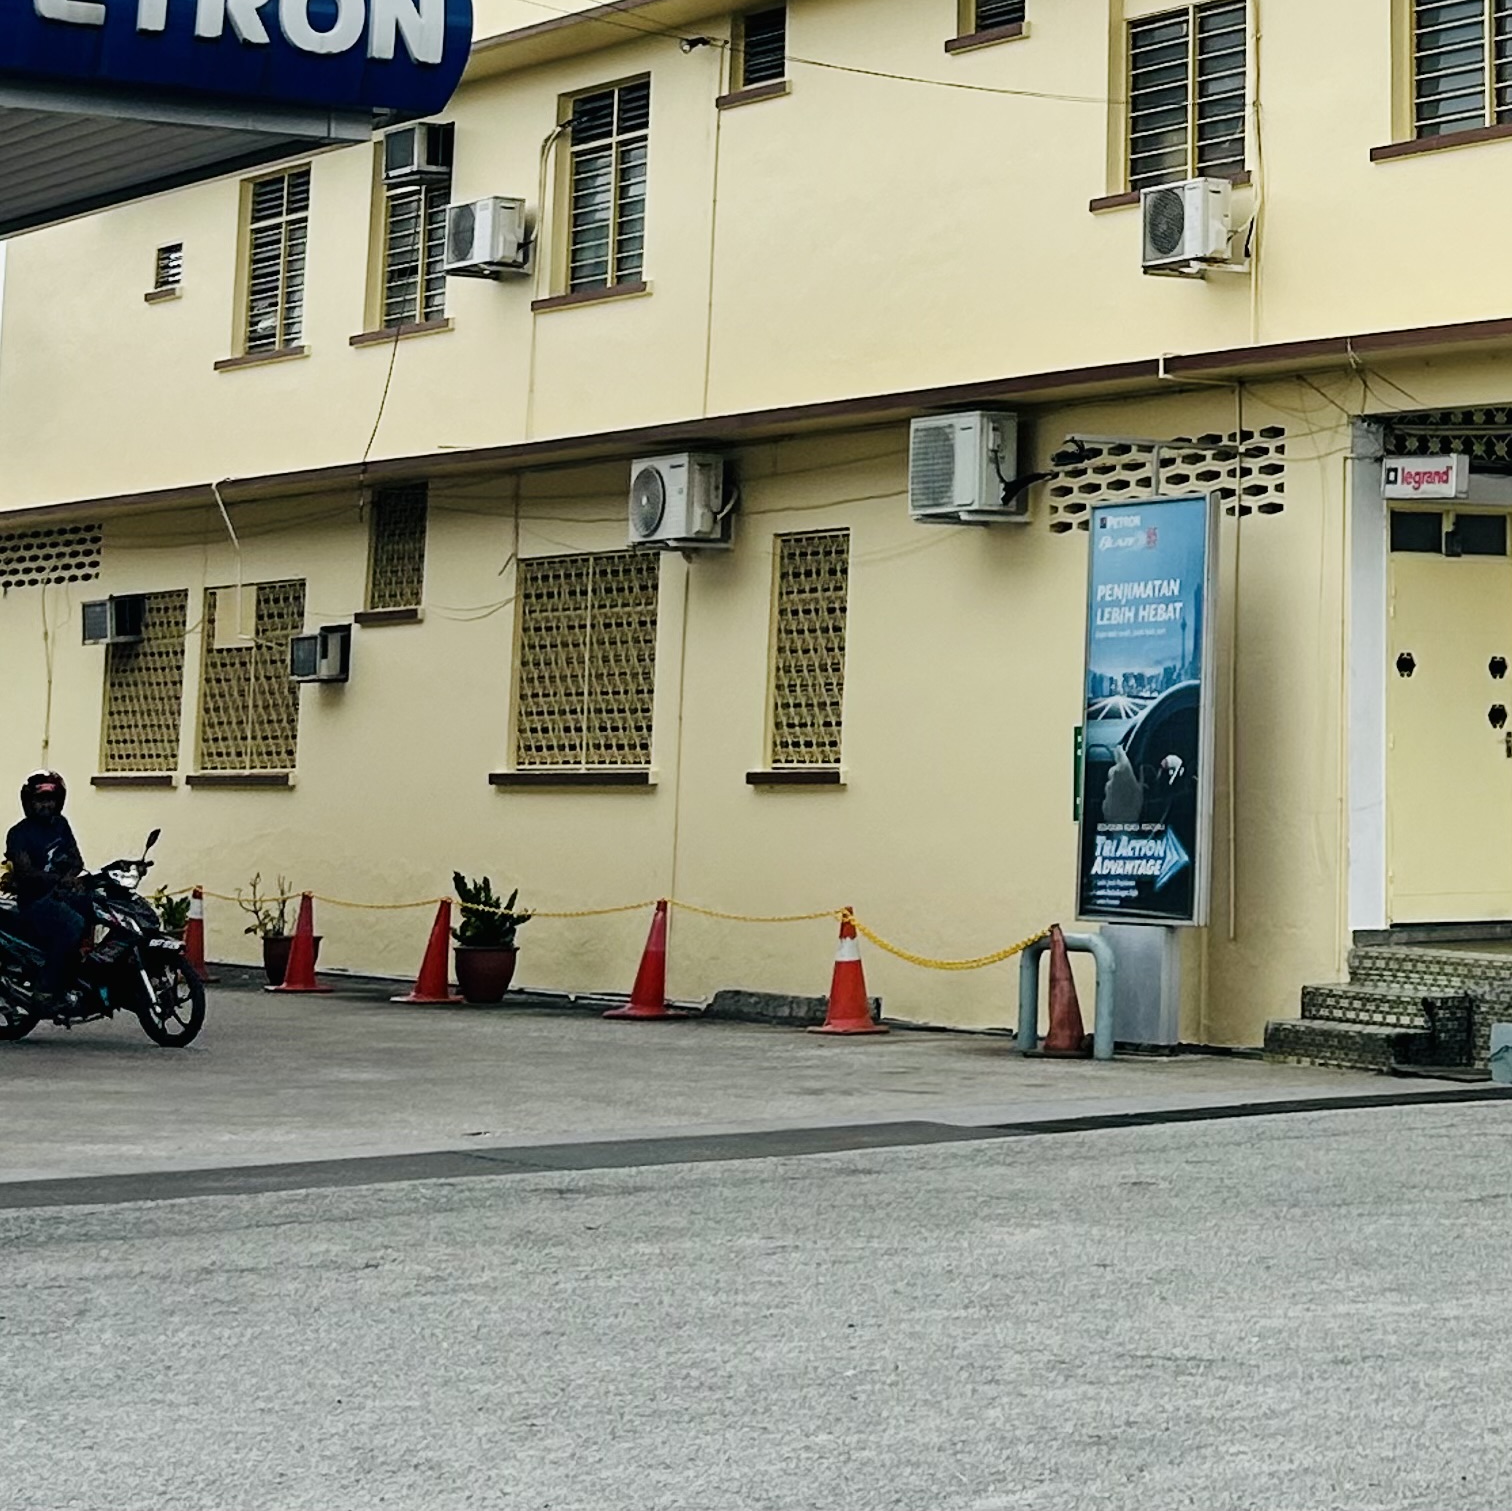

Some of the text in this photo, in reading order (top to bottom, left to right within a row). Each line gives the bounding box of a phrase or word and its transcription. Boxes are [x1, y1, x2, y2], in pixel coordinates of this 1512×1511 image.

[1401, 466, 1449, 491] legrand
[1097, 578, 1180, 605] PENJIMATAN
[1097, 602, 1183, 625] LEBIH HEBAT
